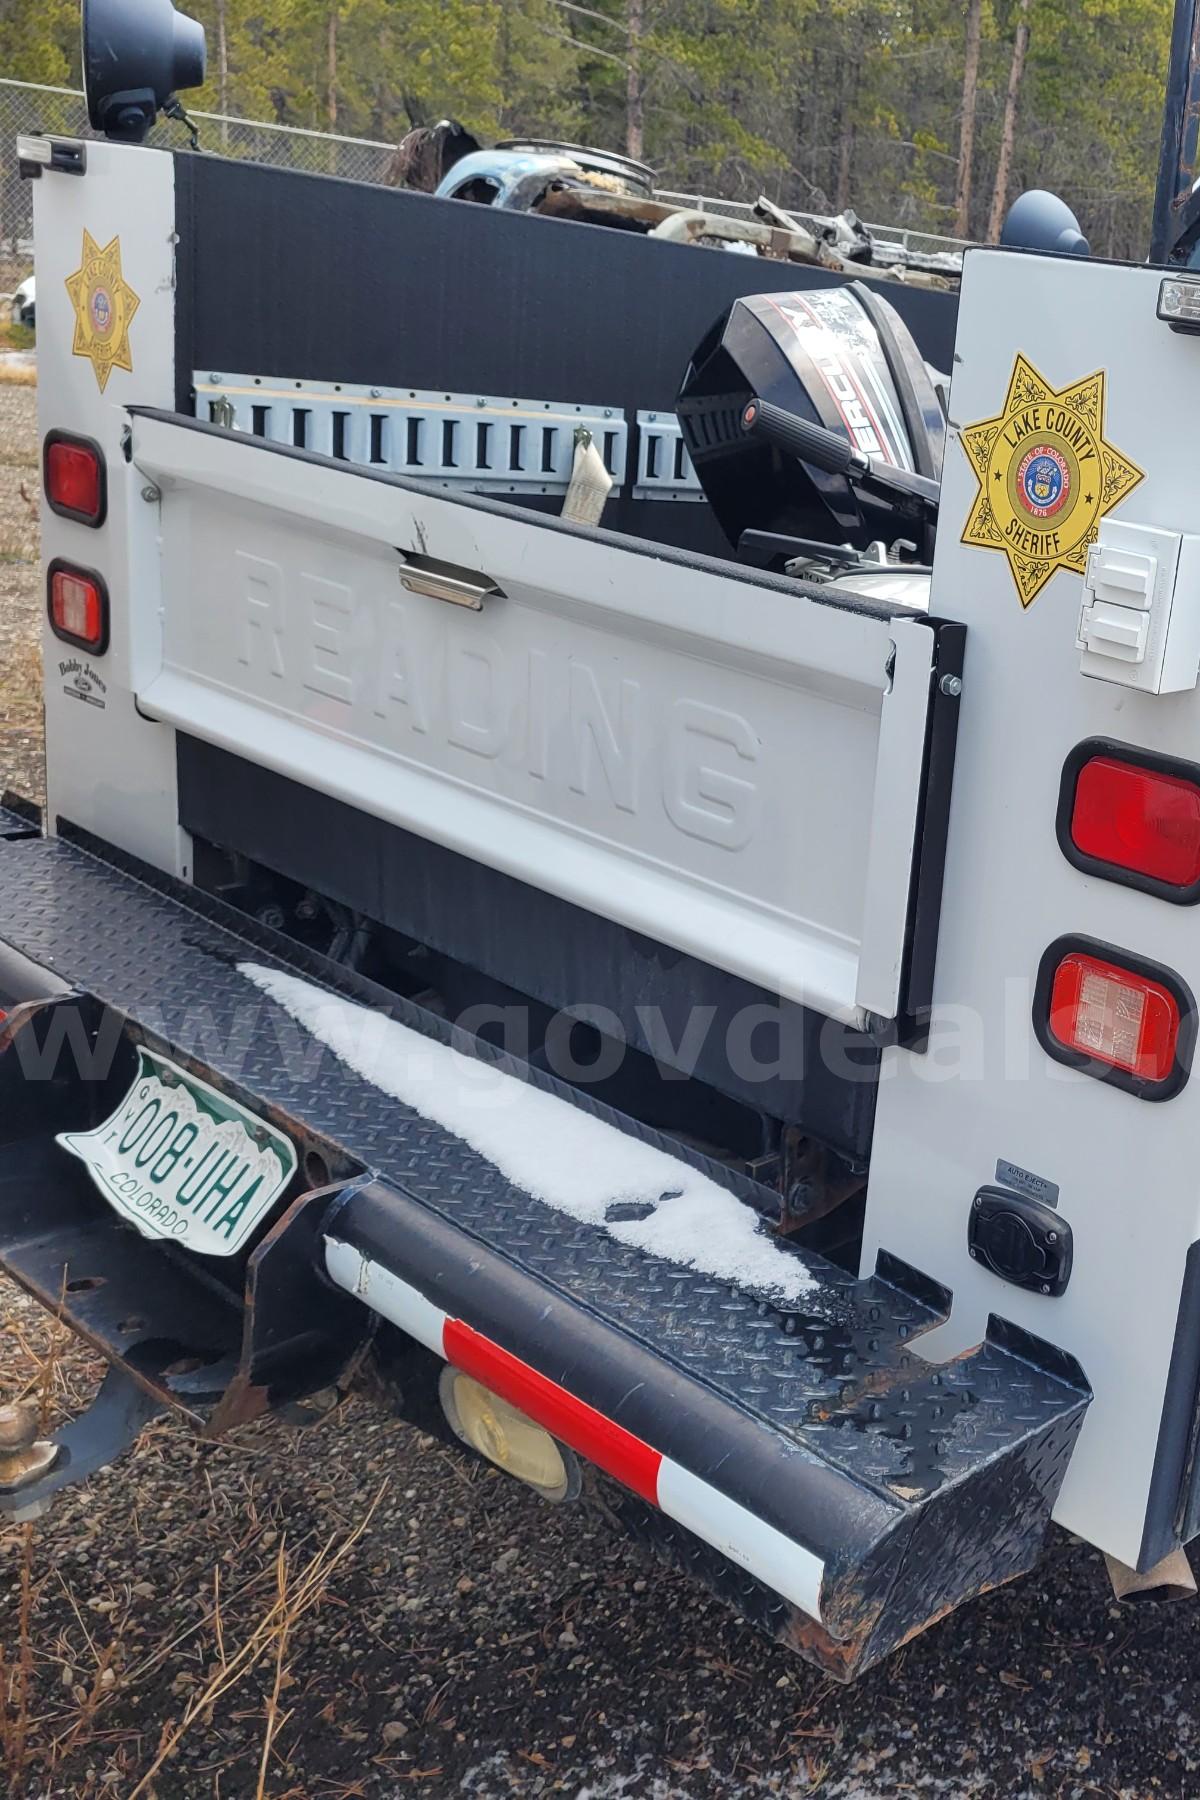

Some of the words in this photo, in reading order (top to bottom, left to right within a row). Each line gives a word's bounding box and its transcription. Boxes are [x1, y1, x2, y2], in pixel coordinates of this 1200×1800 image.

[1003, 408, 1041, 449] LAKE
[1046, 407, 1096, 462] COUNTY
[1018, 454, 1034, 477] STATE
[1034, 446, 1044, 456] OF
[1046, 447, 1070, 489] COLORADO
[1005, 518, 1060, 553] SHERIFF
[1030, 506, 1048, 517] 1876
[234, 549, 760, 854] READING
[110, 1172, 190, 1235] COLORADO
